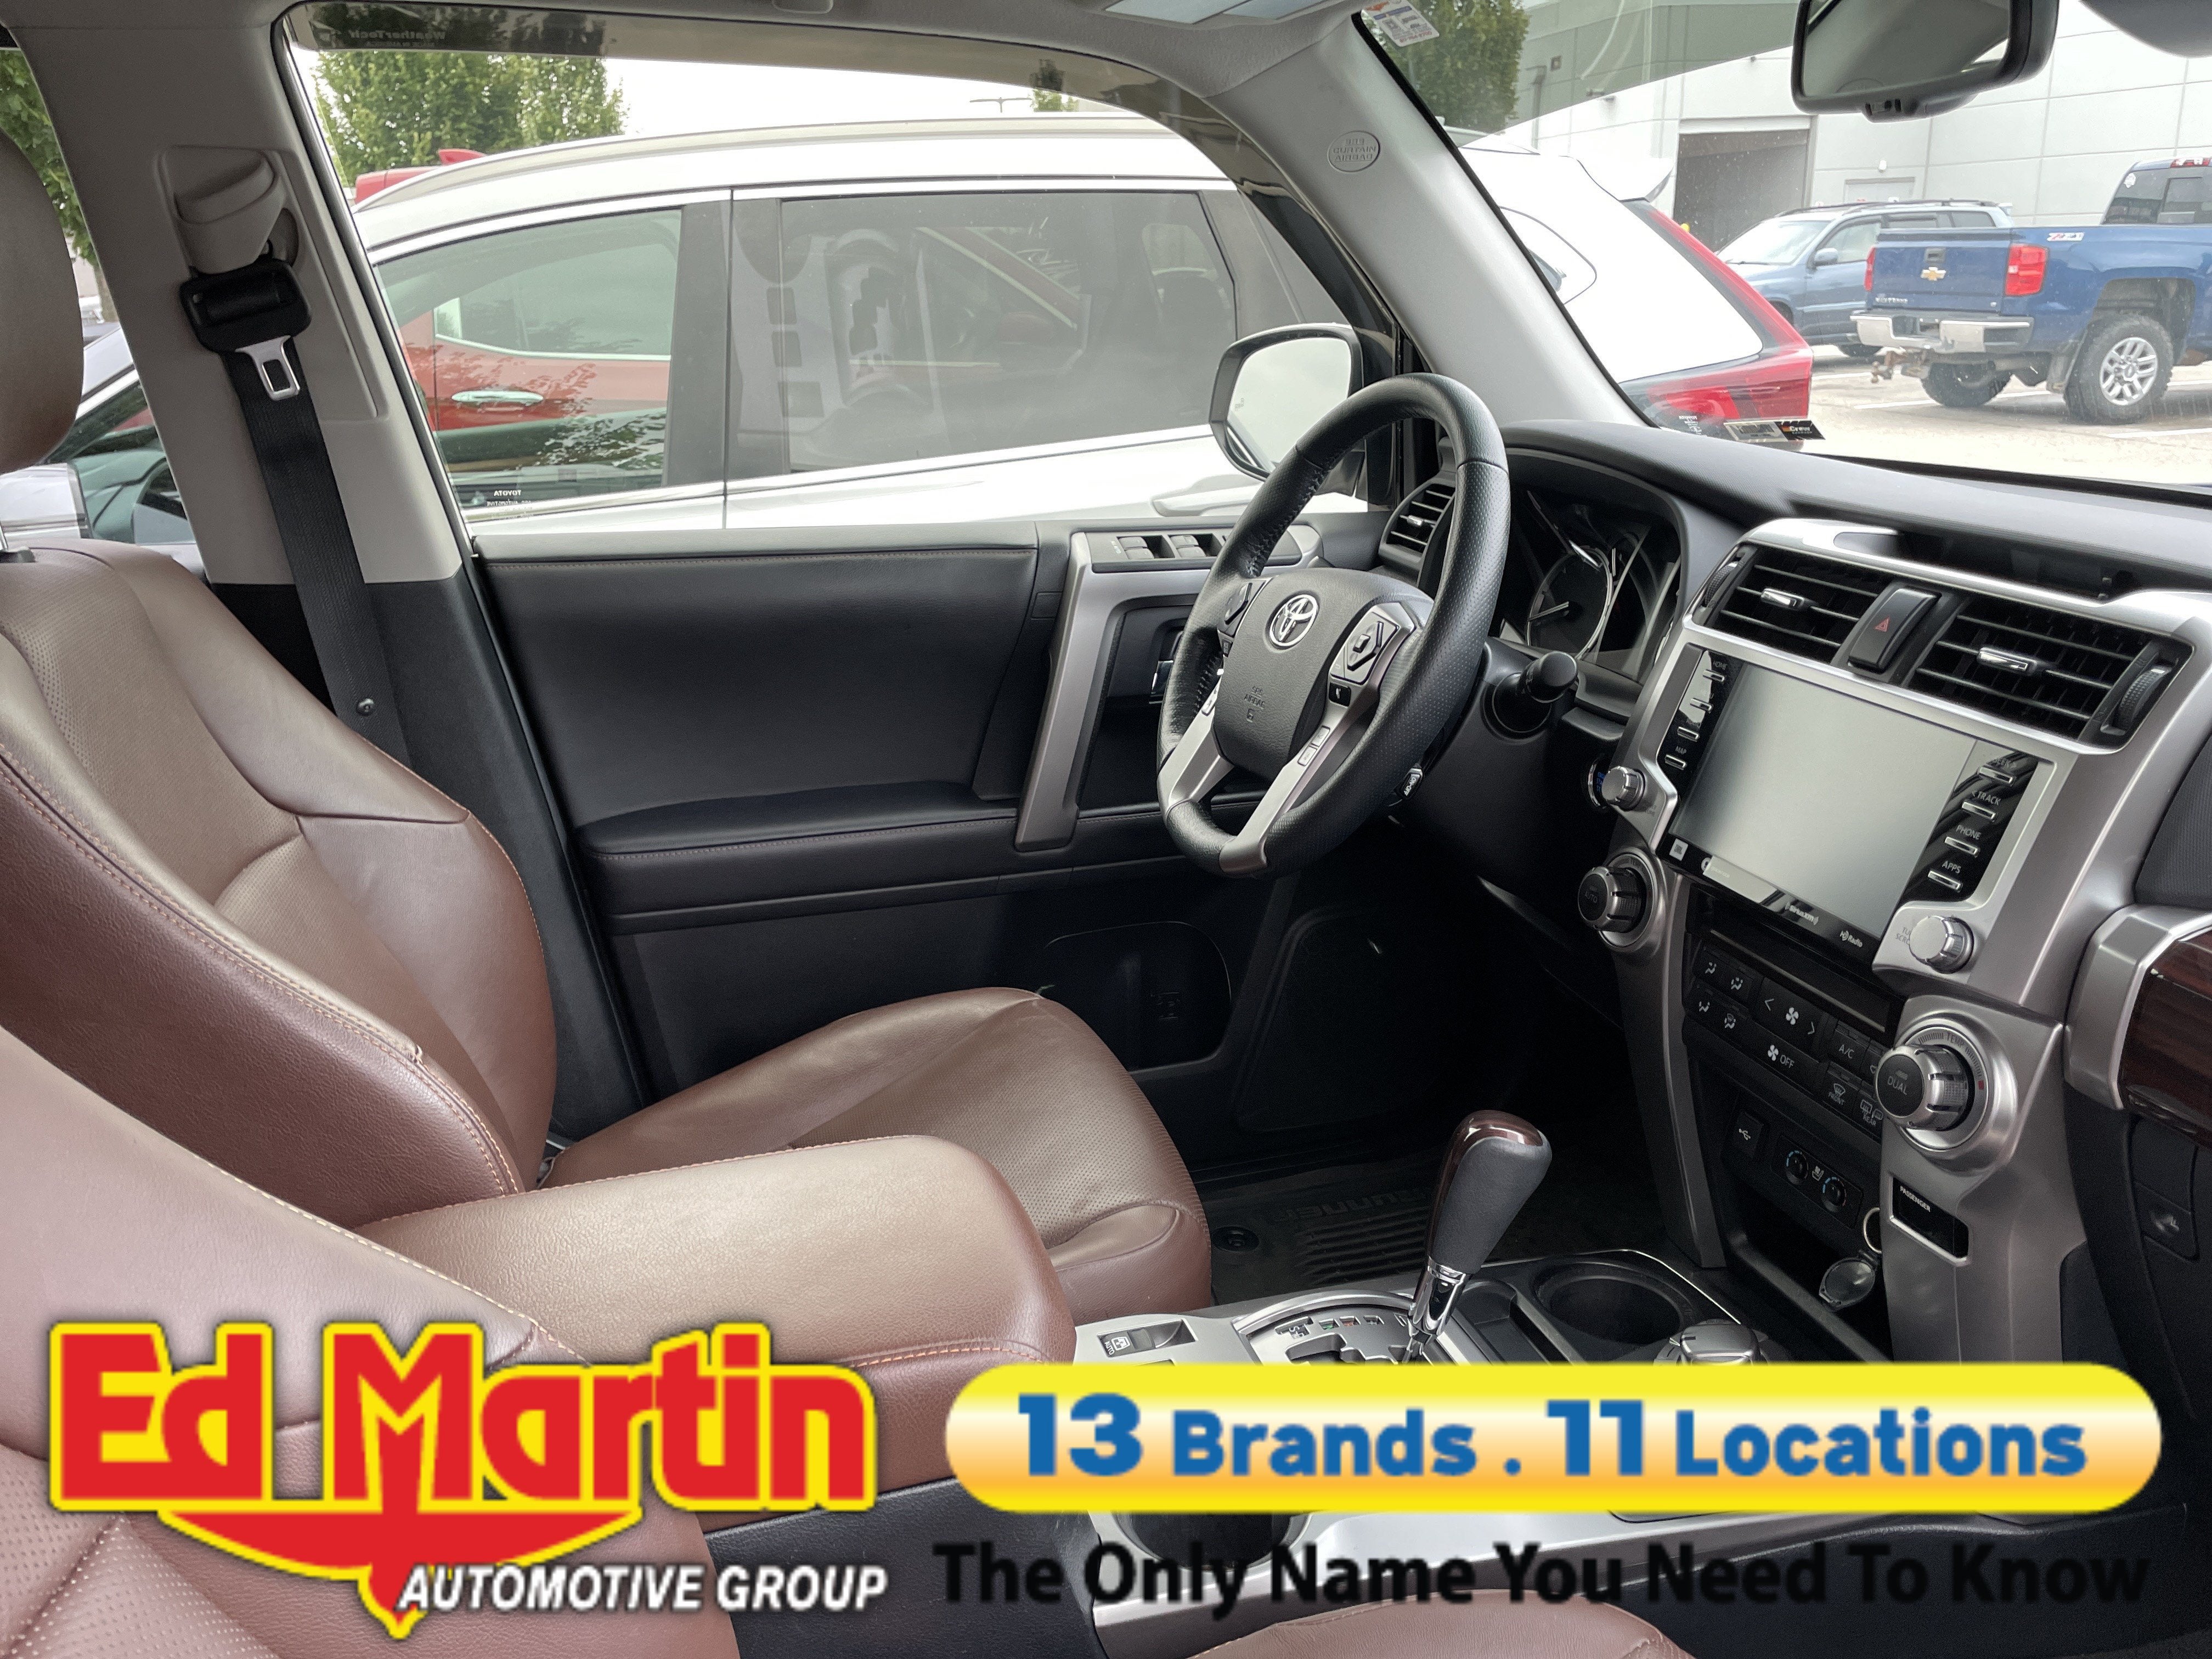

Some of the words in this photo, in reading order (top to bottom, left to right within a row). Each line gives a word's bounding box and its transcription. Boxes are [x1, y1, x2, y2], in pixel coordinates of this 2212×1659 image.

[1713, 661, 1728, 670] HOME
[1675, 746, 1687, 755] MAP
[1977, 791, 2002, 806] TRACK
[1956, 824, 1982, 840] PHONE
[1942, 860, 1962, 874] APPS
[1847, 934, 1863, 947] Radio
[1895, 933, 1910, 945] SCRO
[1838, 1043, 1855, 1059] A/C
[1780, 1054, 1795, 1069] OFF
[1887, 1075, 1908, 1096] DUAL
[1828, 1091, 1846, 1106] FRONT
[1862, 1114, 1877, 1126] REAR
[1900, 1185, 1931, 1212] PASSENGER
[1104, 1341, 1115, 1356] AUTO
